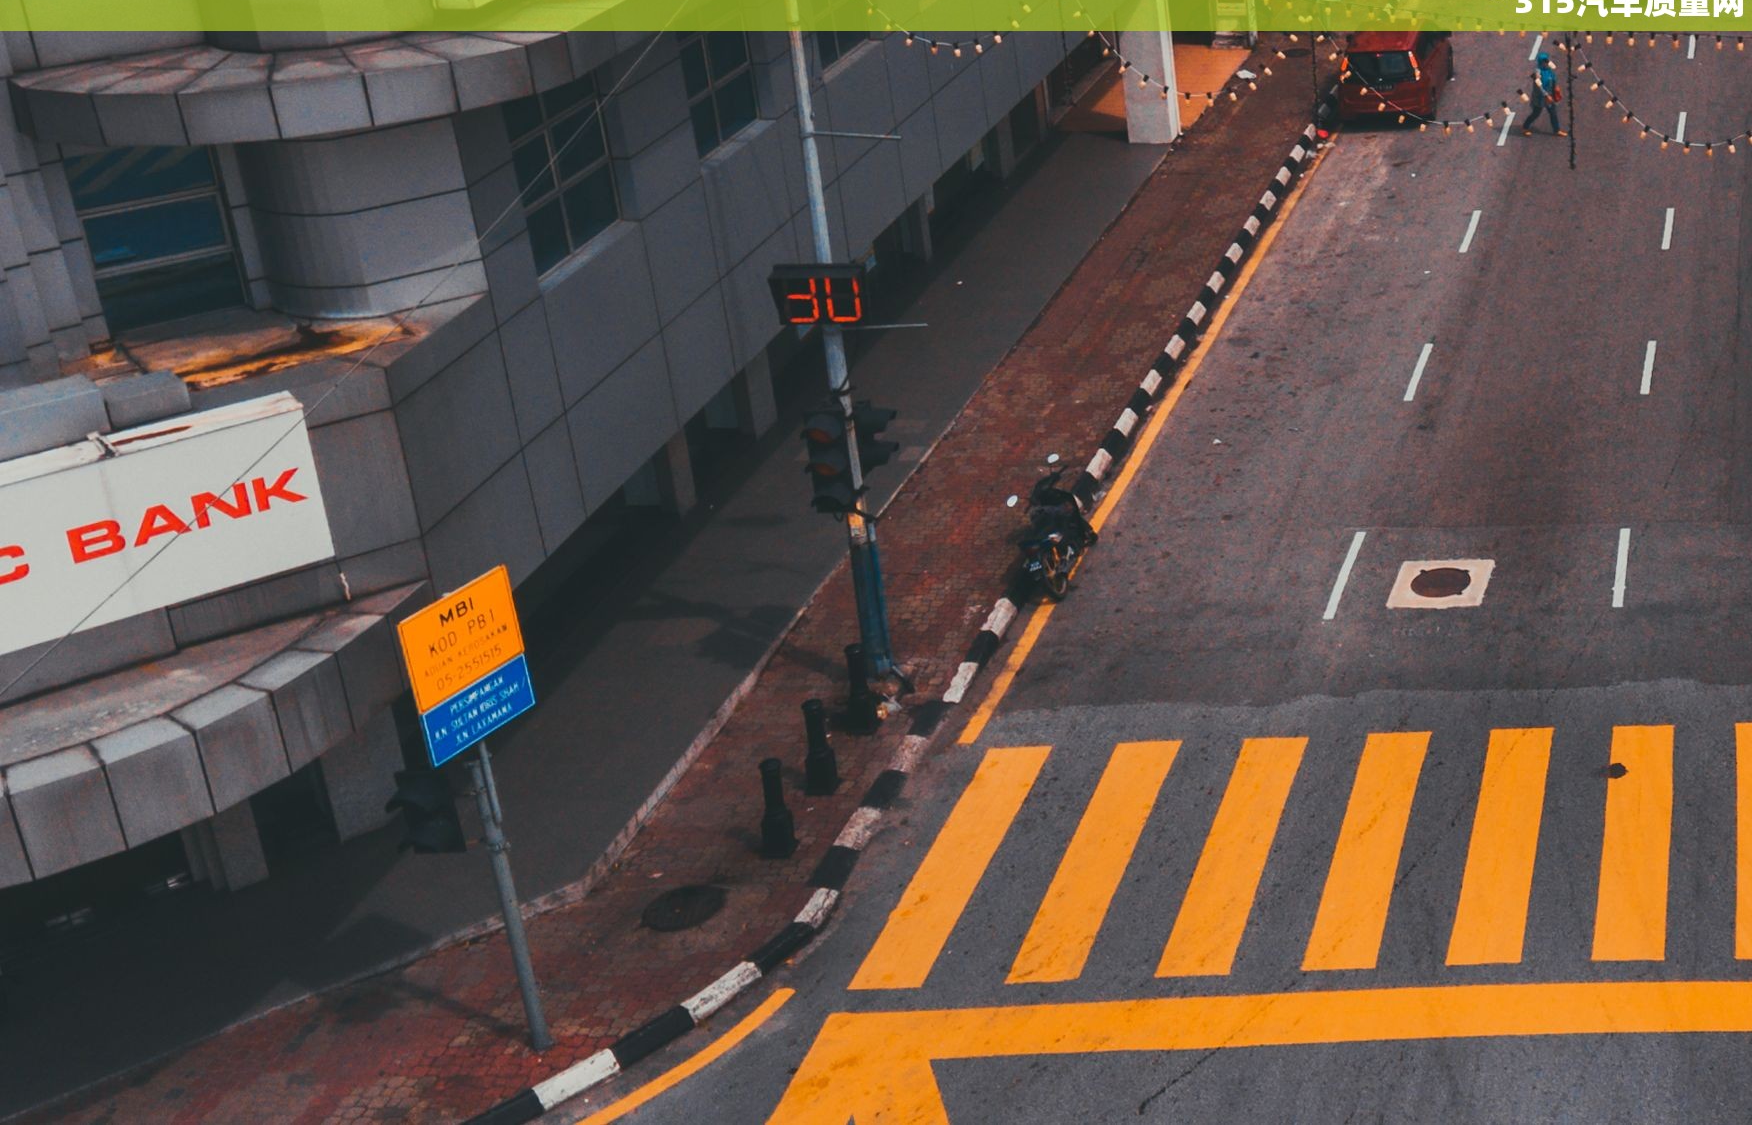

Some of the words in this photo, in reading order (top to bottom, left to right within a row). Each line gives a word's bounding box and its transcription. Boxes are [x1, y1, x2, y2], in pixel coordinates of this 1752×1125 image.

[66, 467, 309, 564] BANK
[439, 597, 473, 627] MBI
[428, 631, 457, 657] KOD
